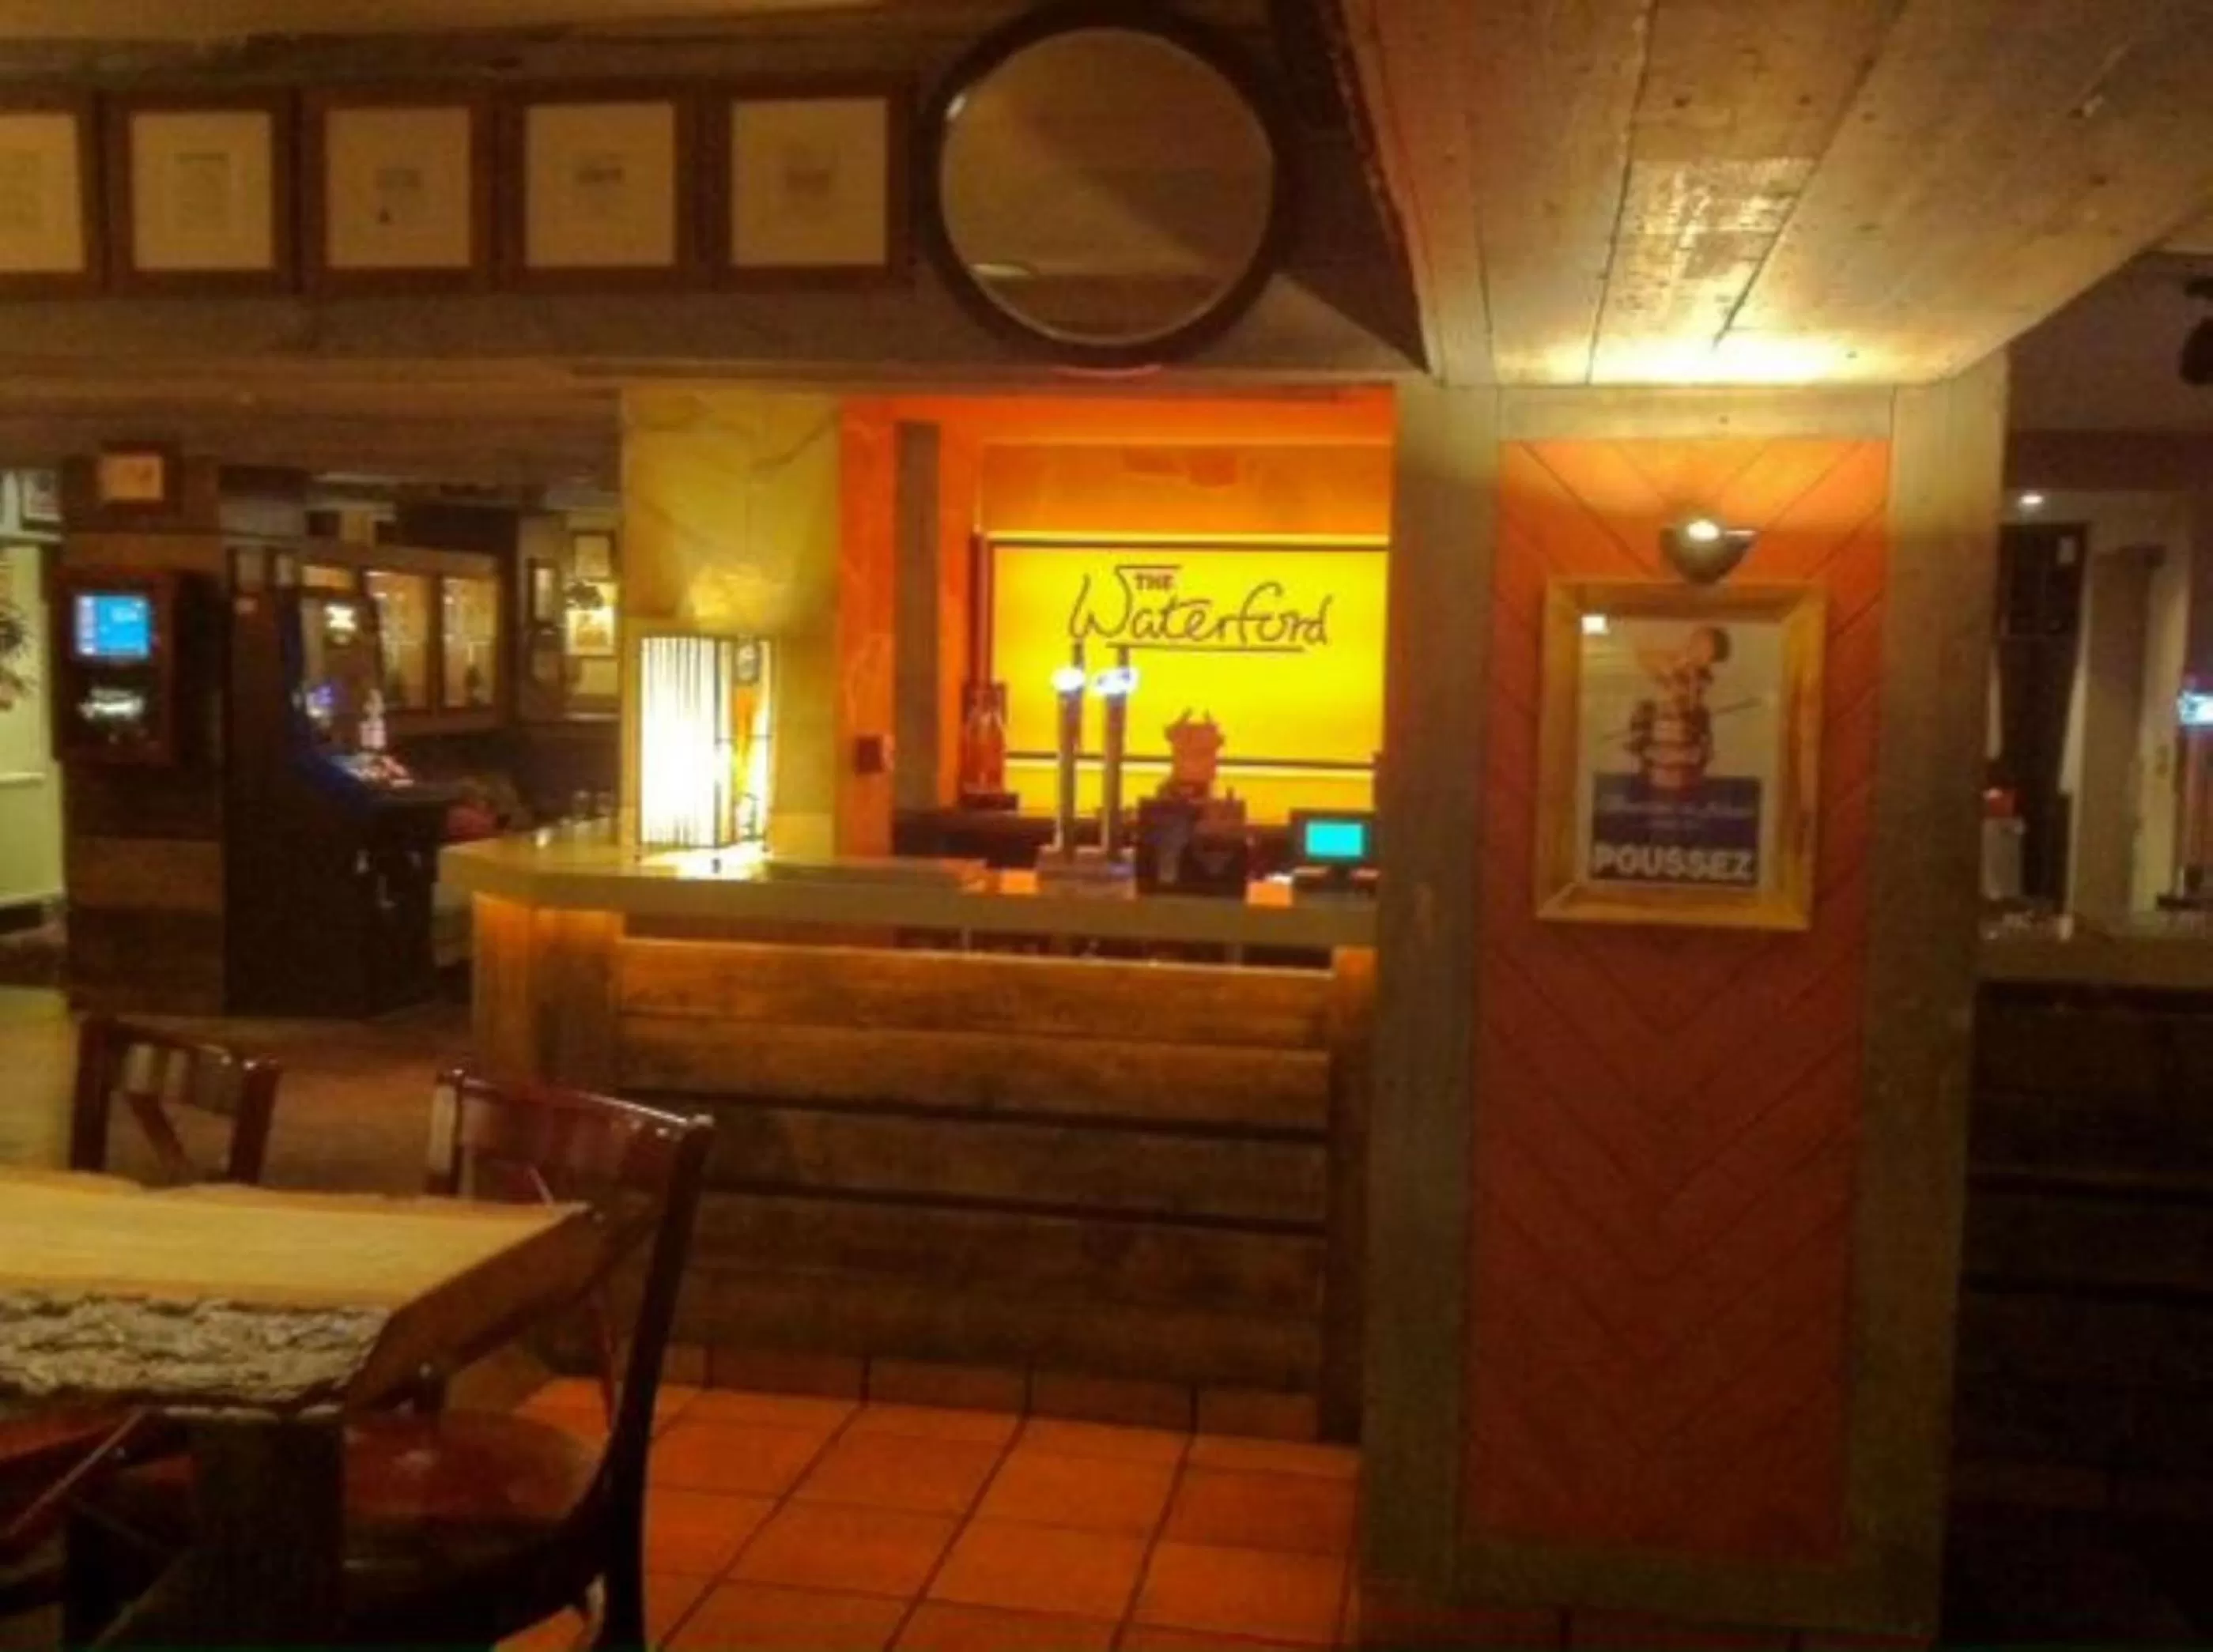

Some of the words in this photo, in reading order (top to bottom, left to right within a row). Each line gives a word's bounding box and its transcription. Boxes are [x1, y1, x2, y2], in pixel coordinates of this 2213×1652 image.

[1135, 574, 1174, 590] THE
[1069, 564, 1333, 645] Waterford
[1594, 843, 1752, 878] POUSSEZ
